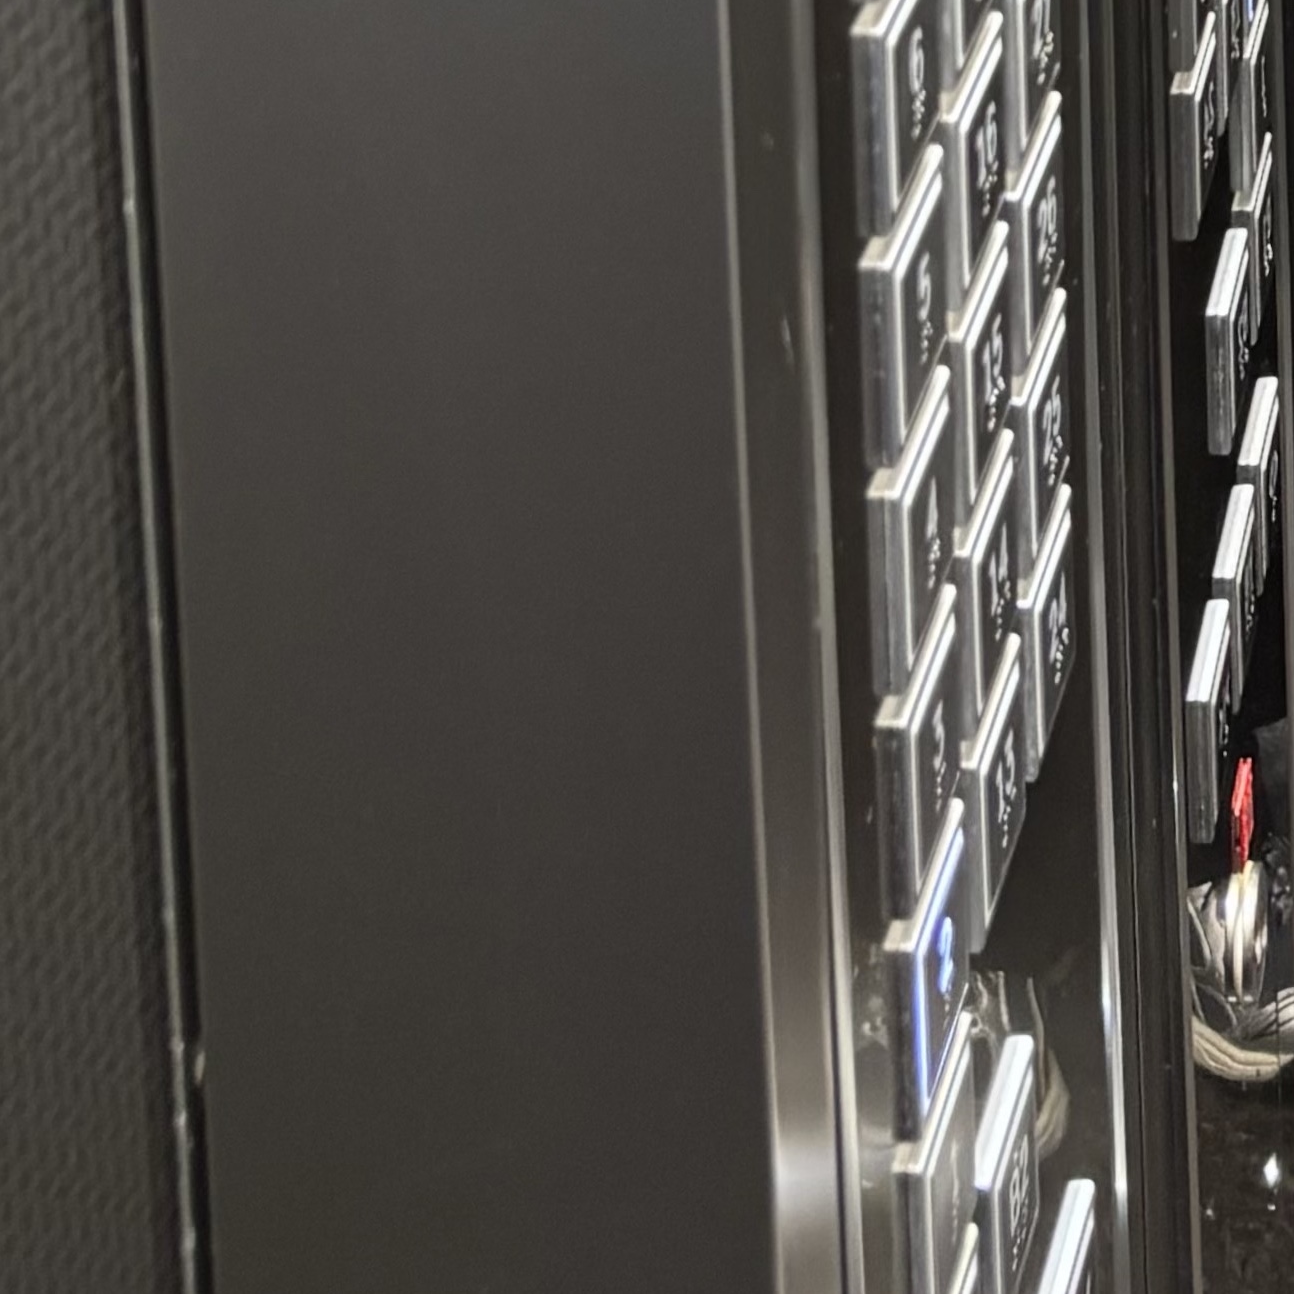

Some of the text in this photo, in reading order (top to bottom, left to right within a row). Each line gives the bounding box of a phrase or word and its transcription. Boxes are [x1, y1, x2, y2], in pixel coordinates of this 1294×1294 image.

[908, 26, 925, 95] 6
[916, 252, 931, 322] 5
[1042, 375, 1061, 465] 25
